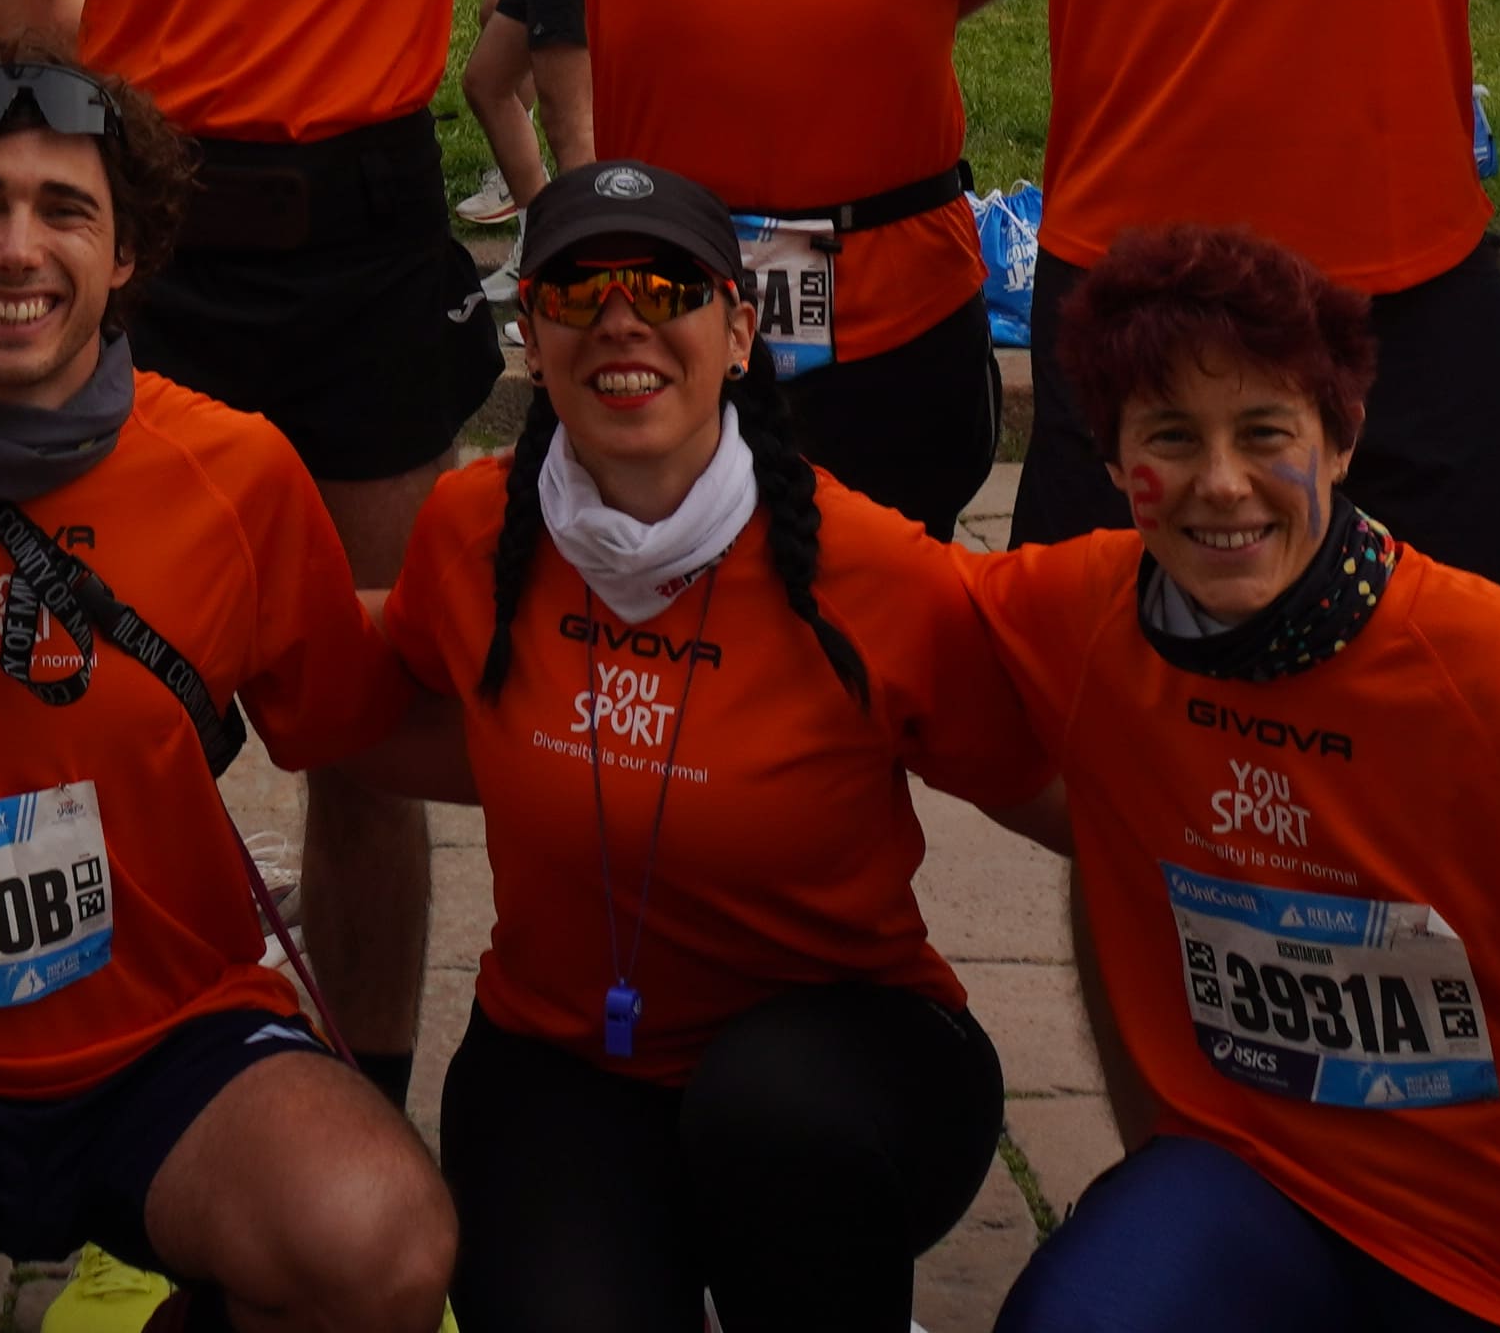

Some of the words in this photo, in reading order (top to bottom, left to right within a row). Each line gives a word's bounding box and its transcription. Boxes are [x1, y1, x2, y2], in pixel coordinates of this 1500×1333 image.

[45, 583, 77, 614] OF
[559, 613, 723, 669] GIVOVA
[597, 662, 660, 710] YOU
[571, 691, 675, 747] SPORT
[1187, 698, 1353, 762] GIVOVA
[533, 730, 598, 766] Diversity
[602, 748, 615, 766] is
[619, 753, 646, 772] our
[650, 758, 709, 784] normal
[1228, 758, 1290, 809] YOU
[1211, 789, 1311, 847] SPORT
[1251, 846, 1265, 867] is
[1270, 854, 1298, 871] our
[1302, 860, 1359, 887] normal
[1186, 882, 1258, 913] UniCredit
[1307, 907, 1354, 924] RELAY
[1226, 951, 1431, 1054] 3931A
[1234, 1047, 1278, 1072] asics
